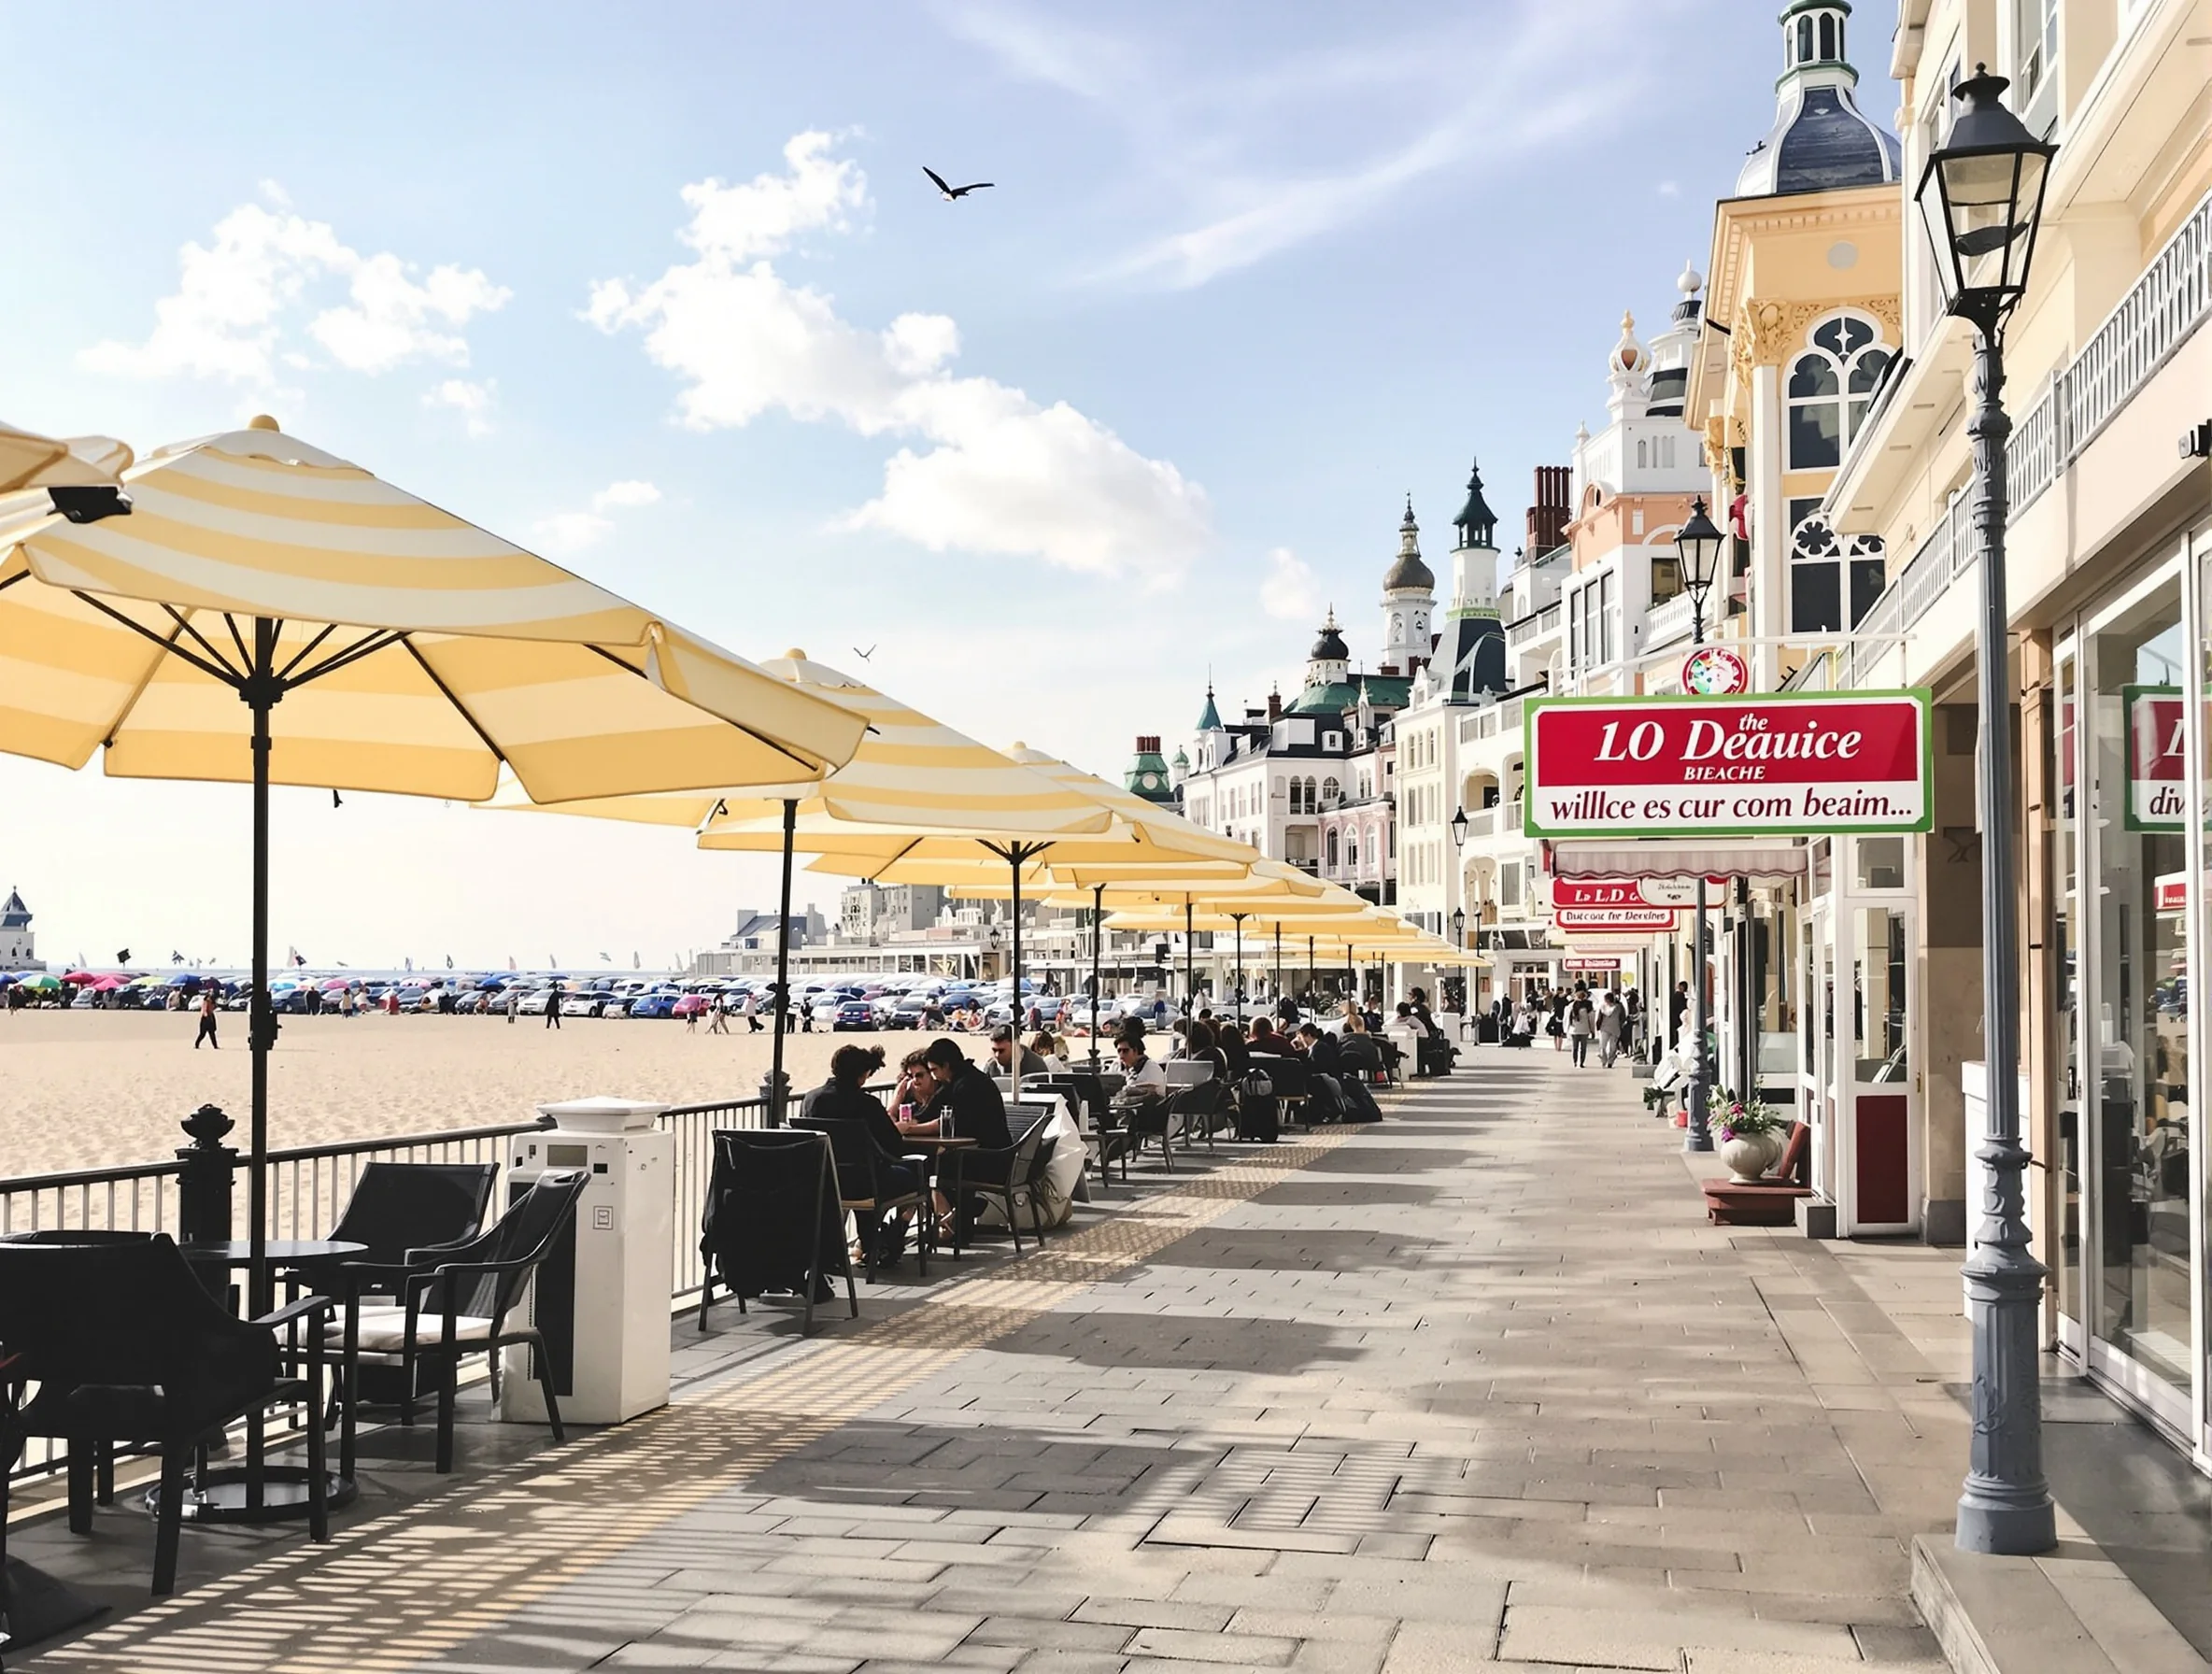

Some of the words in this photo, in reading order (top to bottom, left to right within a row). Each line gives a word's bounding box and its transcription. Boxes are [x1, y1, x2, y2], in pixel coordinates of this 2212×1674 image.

[1738, 713, 1768, 731] the
[1643, 800, 1671, 819] es
[1678, 800, 1726, 819] cur
[1733, 798, 1792, 818] com
